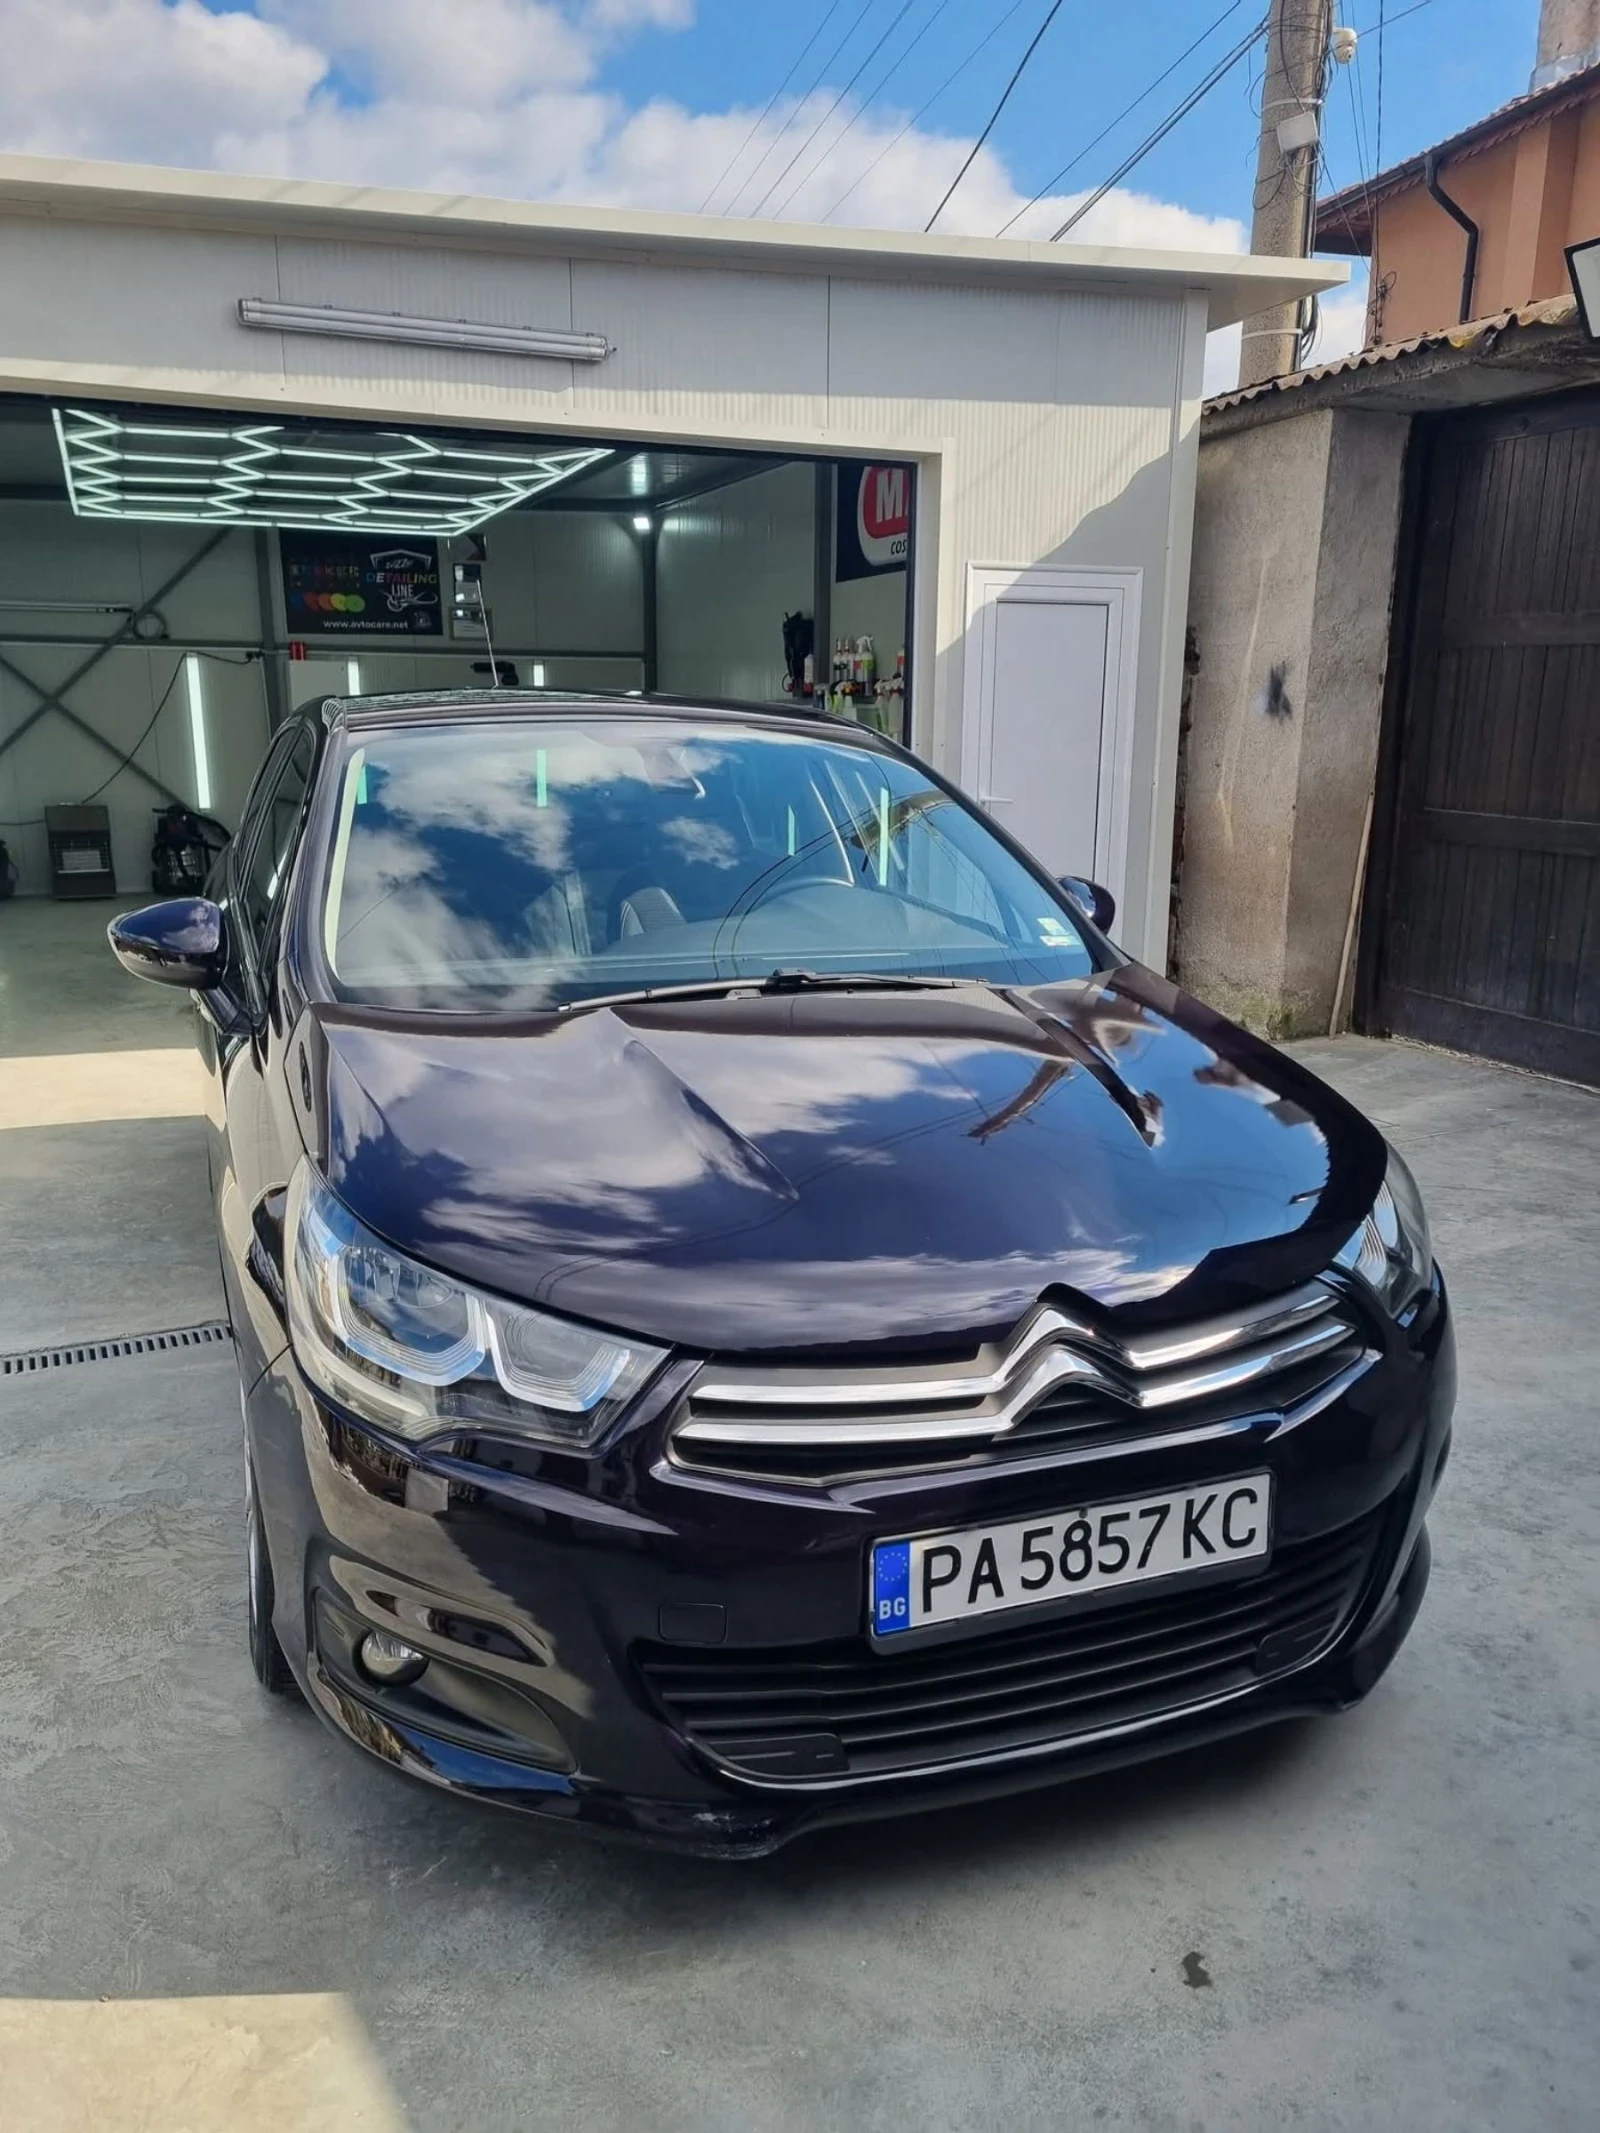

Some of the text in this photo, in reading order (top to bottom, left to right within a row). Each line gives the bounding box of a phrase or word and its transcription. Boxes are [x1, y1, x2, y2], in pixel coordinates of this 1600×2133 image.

[876, 468, 908, 523] M
[365, 572, 437, 584] DETAILING
[391, 584, 414, 597] LINE
[323, 619, 409, 630] www.avtocare.net
[1020, 1503, 1172, 1590] 5857
[1182, 1487, 1258, 1559] KC
[878, 1597, 906, 1621] BG
